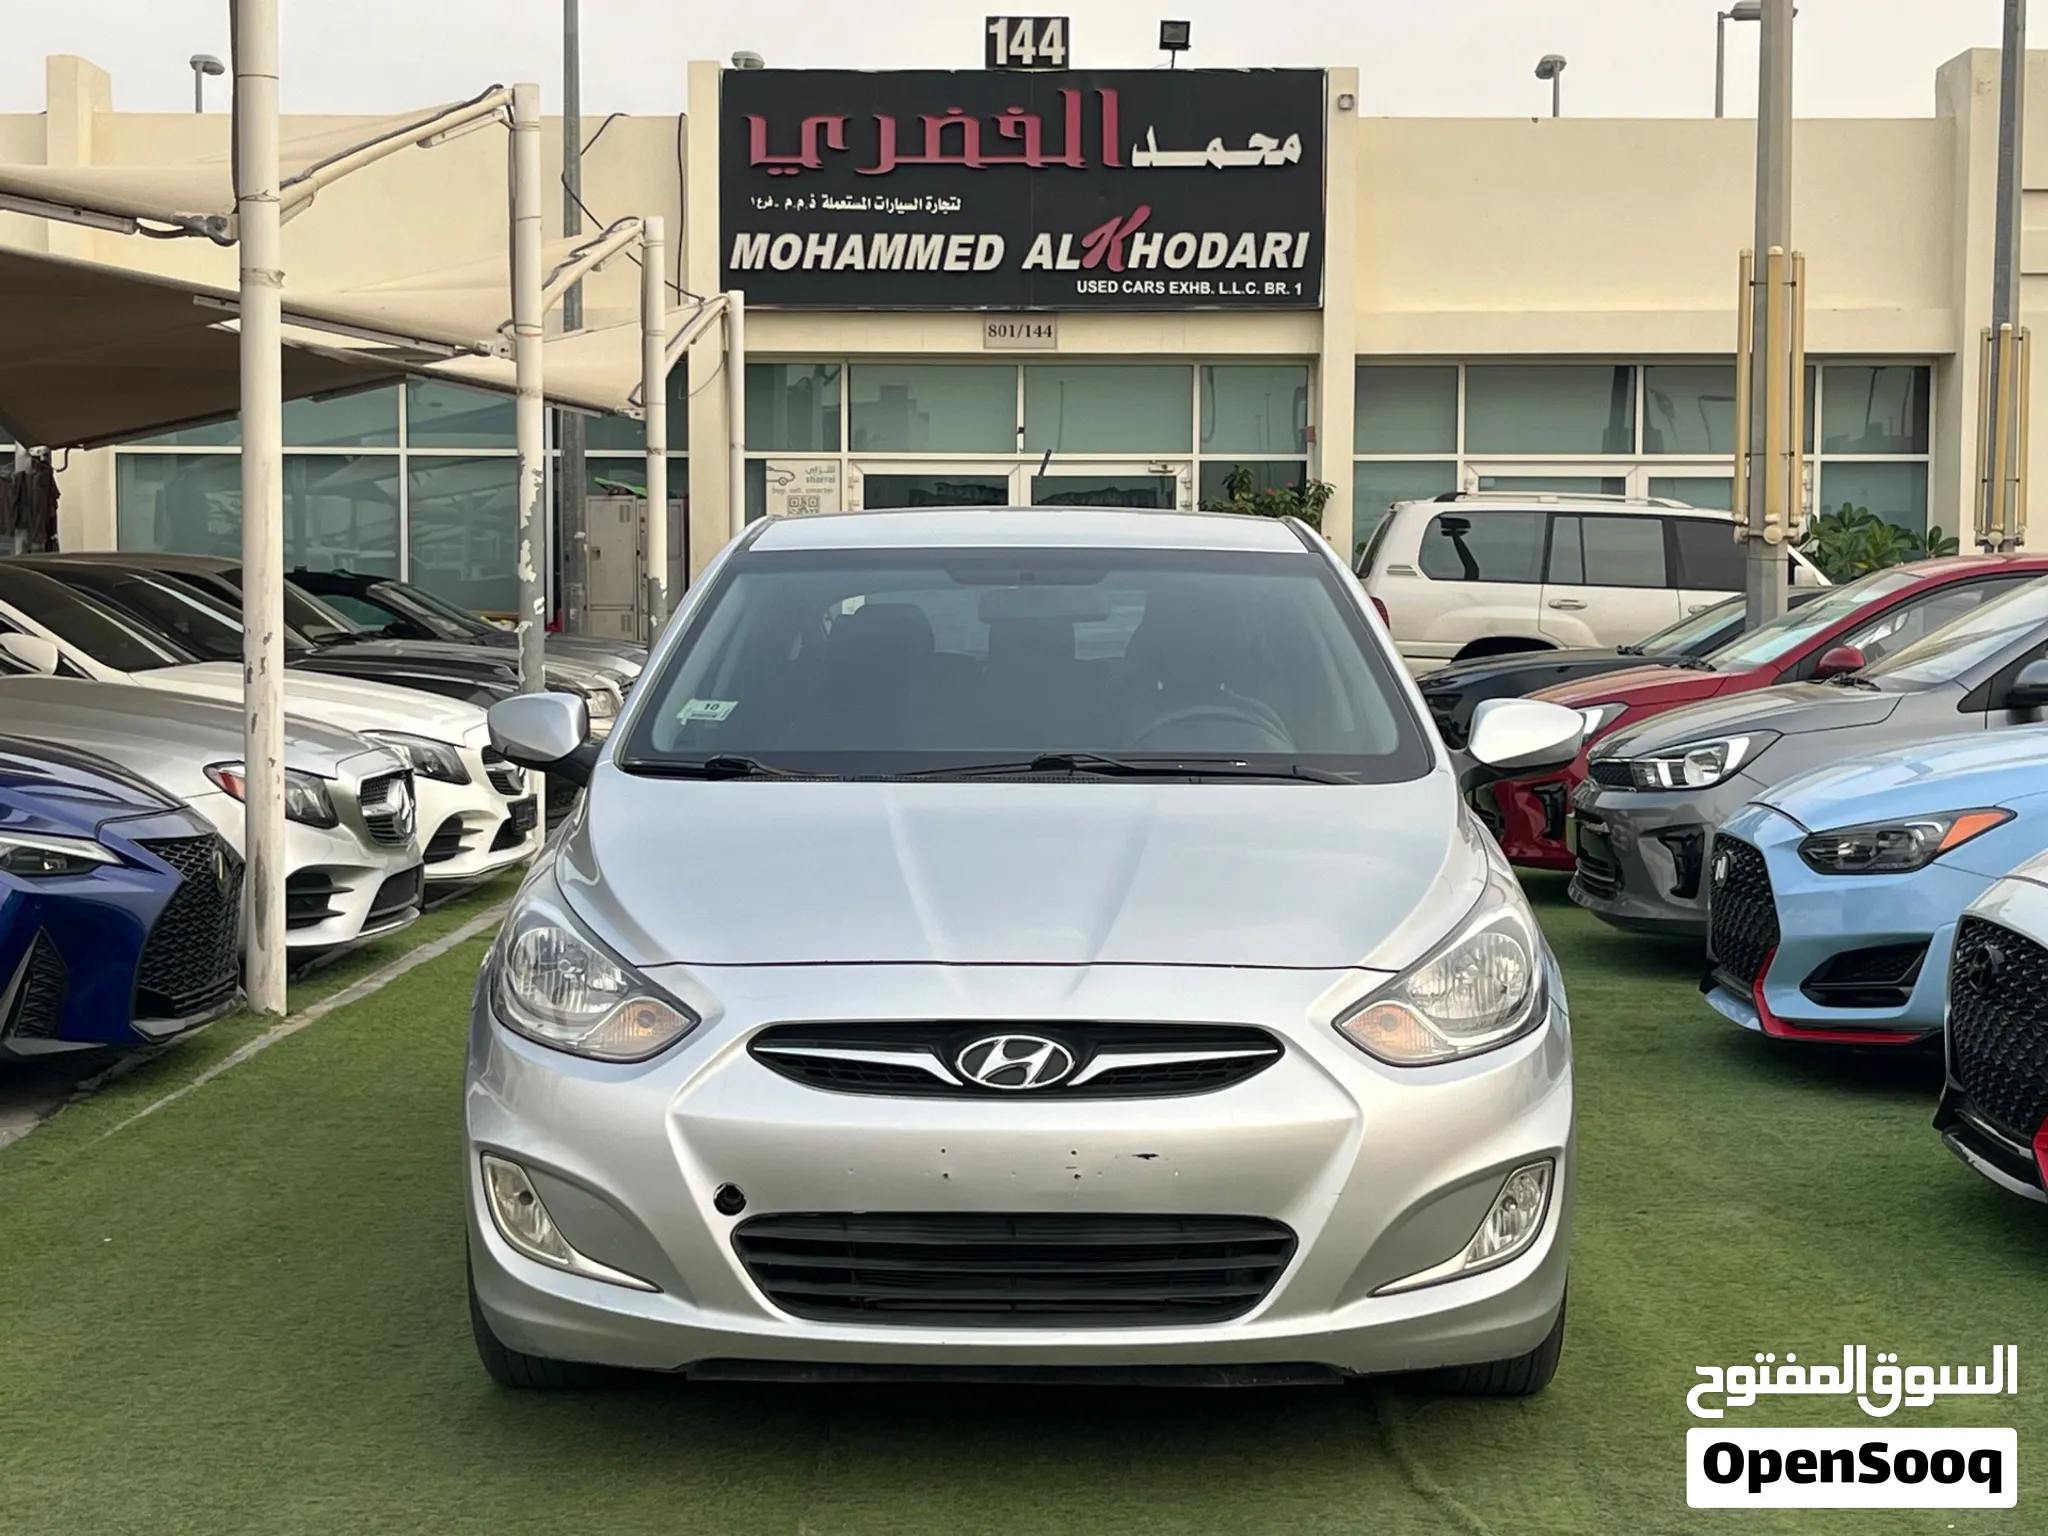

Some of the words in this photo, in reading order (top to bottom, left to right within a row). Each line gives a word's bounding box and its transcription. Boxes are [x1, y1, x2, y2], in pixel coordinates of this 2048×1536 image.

[988, 18, 1066, 65] 144
[742, 88, 1126, 175] الخضري
[1131, 125, 1302, 169] محمد
[821, 193, 871, 211] المستعملة
[873, 195, 923, 215] السيارات
[925, 195, 961, 215] لتجارة
[728, 232, 1005, 271] MOHAMMED
[1076, 280, 1119, 294] USED
[1122, 281, 1166, 295] CARS
[1169, 281, 1215, 295] EXHB.
[1219, 282, 1261, 295] L.L.C.
[1264, 282, 1290, 295] BR.
[1294, 282, 1302, 296] 1
[987, 323, 1053, 339] 801/144
